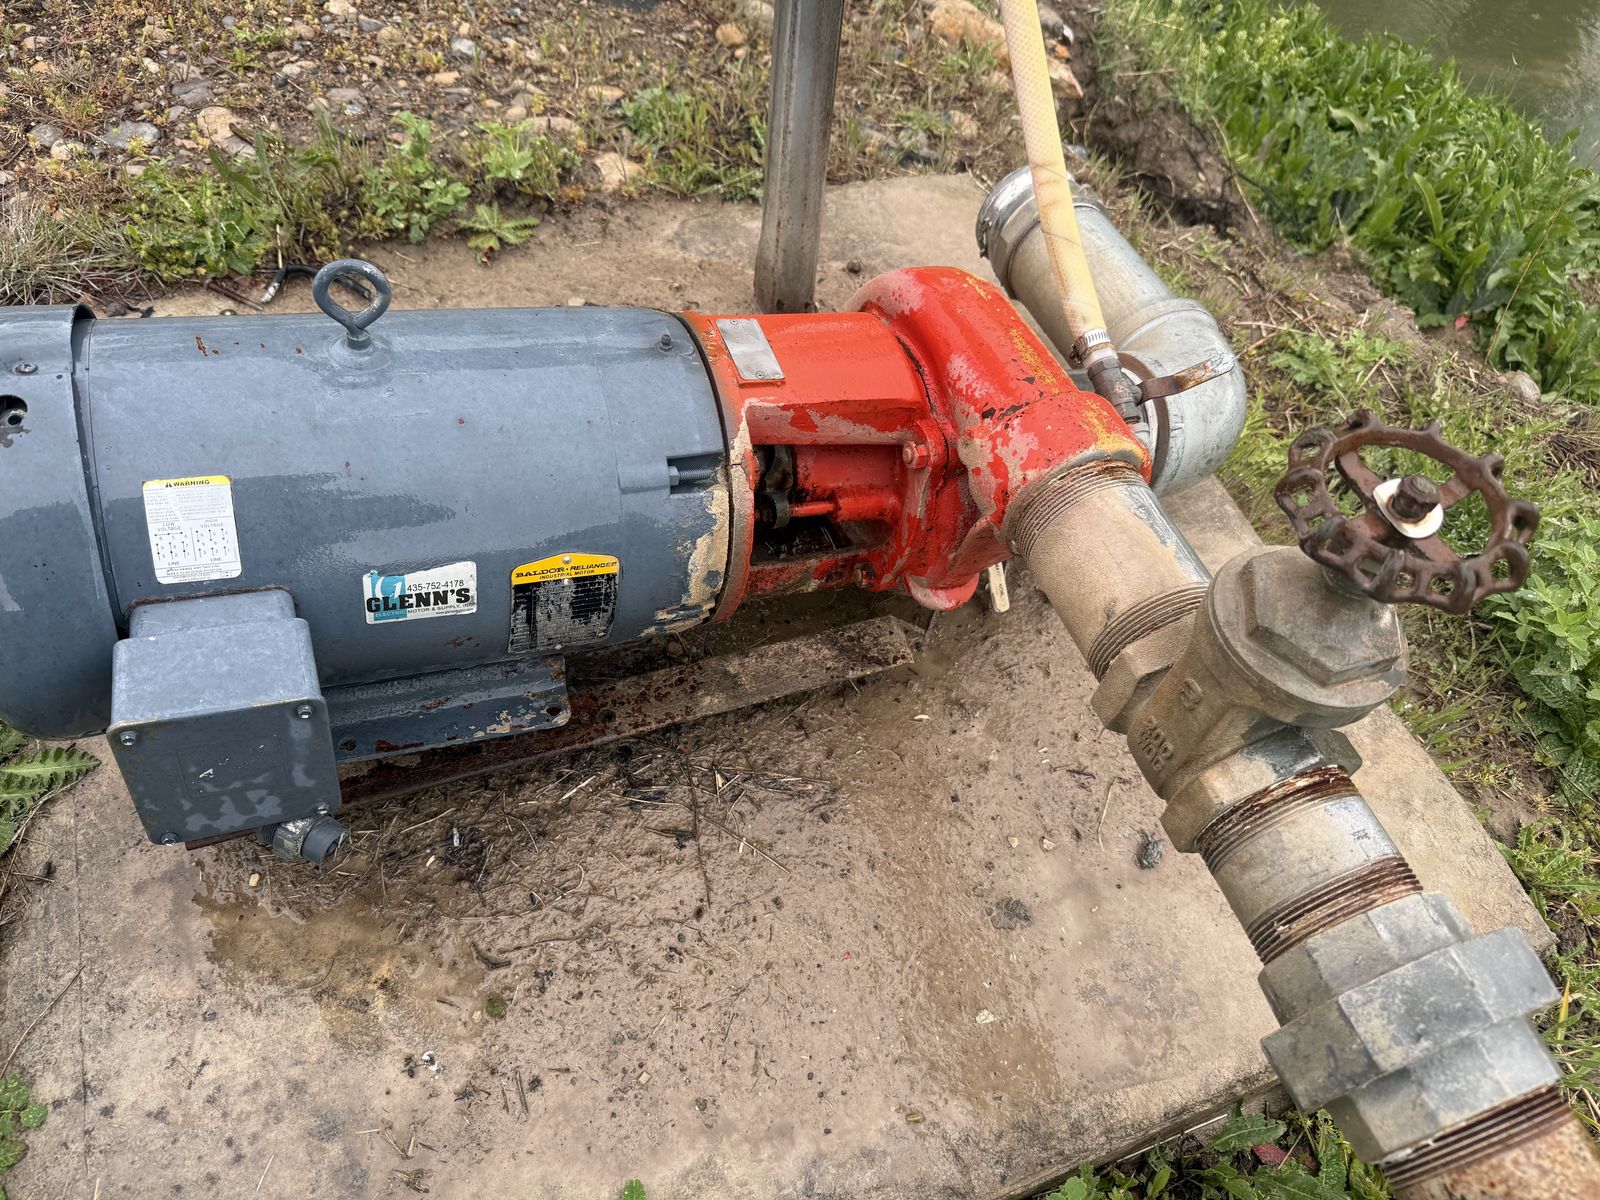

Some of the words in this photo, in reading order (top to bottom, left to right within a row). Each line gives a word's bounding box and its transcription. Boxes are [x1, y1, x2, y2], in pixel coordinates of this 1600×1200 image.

[516, 567, 564, 578] BALDOR
[540, 572, 572, 580] INDUSTRIAL
[407, 580, 465, 592] 435-752-4178
[366, 588, 471, 613] GLENN'S
